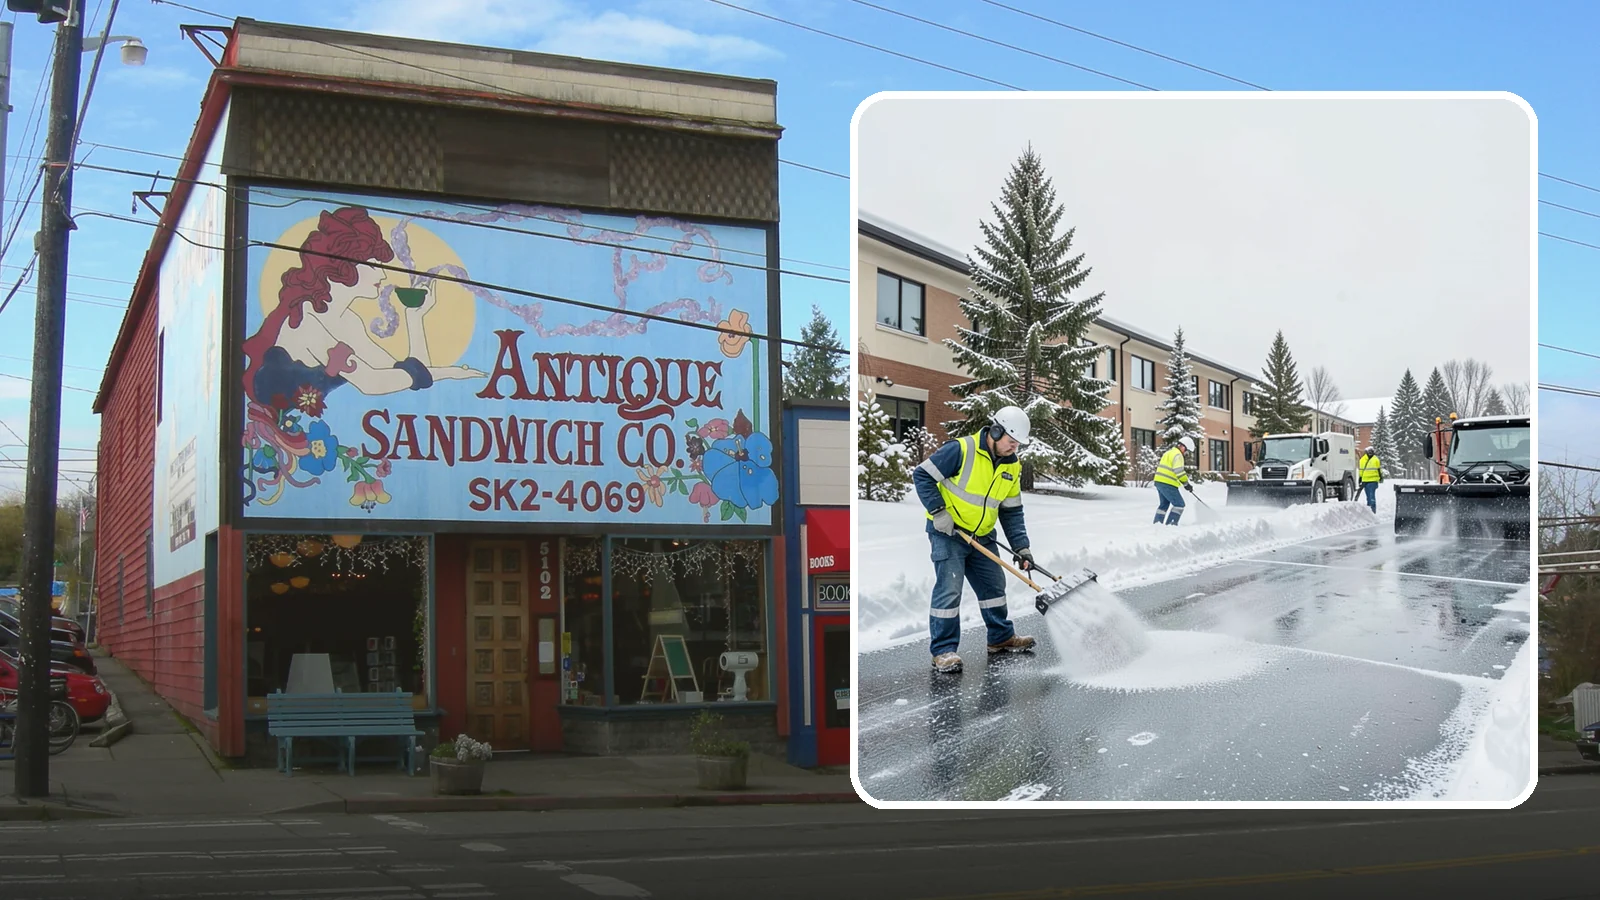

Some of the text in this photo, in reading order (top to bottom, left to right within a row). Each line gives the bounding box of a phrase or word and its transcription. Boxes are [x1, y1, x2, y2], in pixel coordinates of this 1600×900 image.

[476, 328, 724, 421] ANTIQUE
[361, 408, 685, 468] SANDWICH CO.
[468, 476, 646, 513] SK2-4069
[540, 542, 552, 600] 5102
[809, 555, 835, 568] BOOKS
